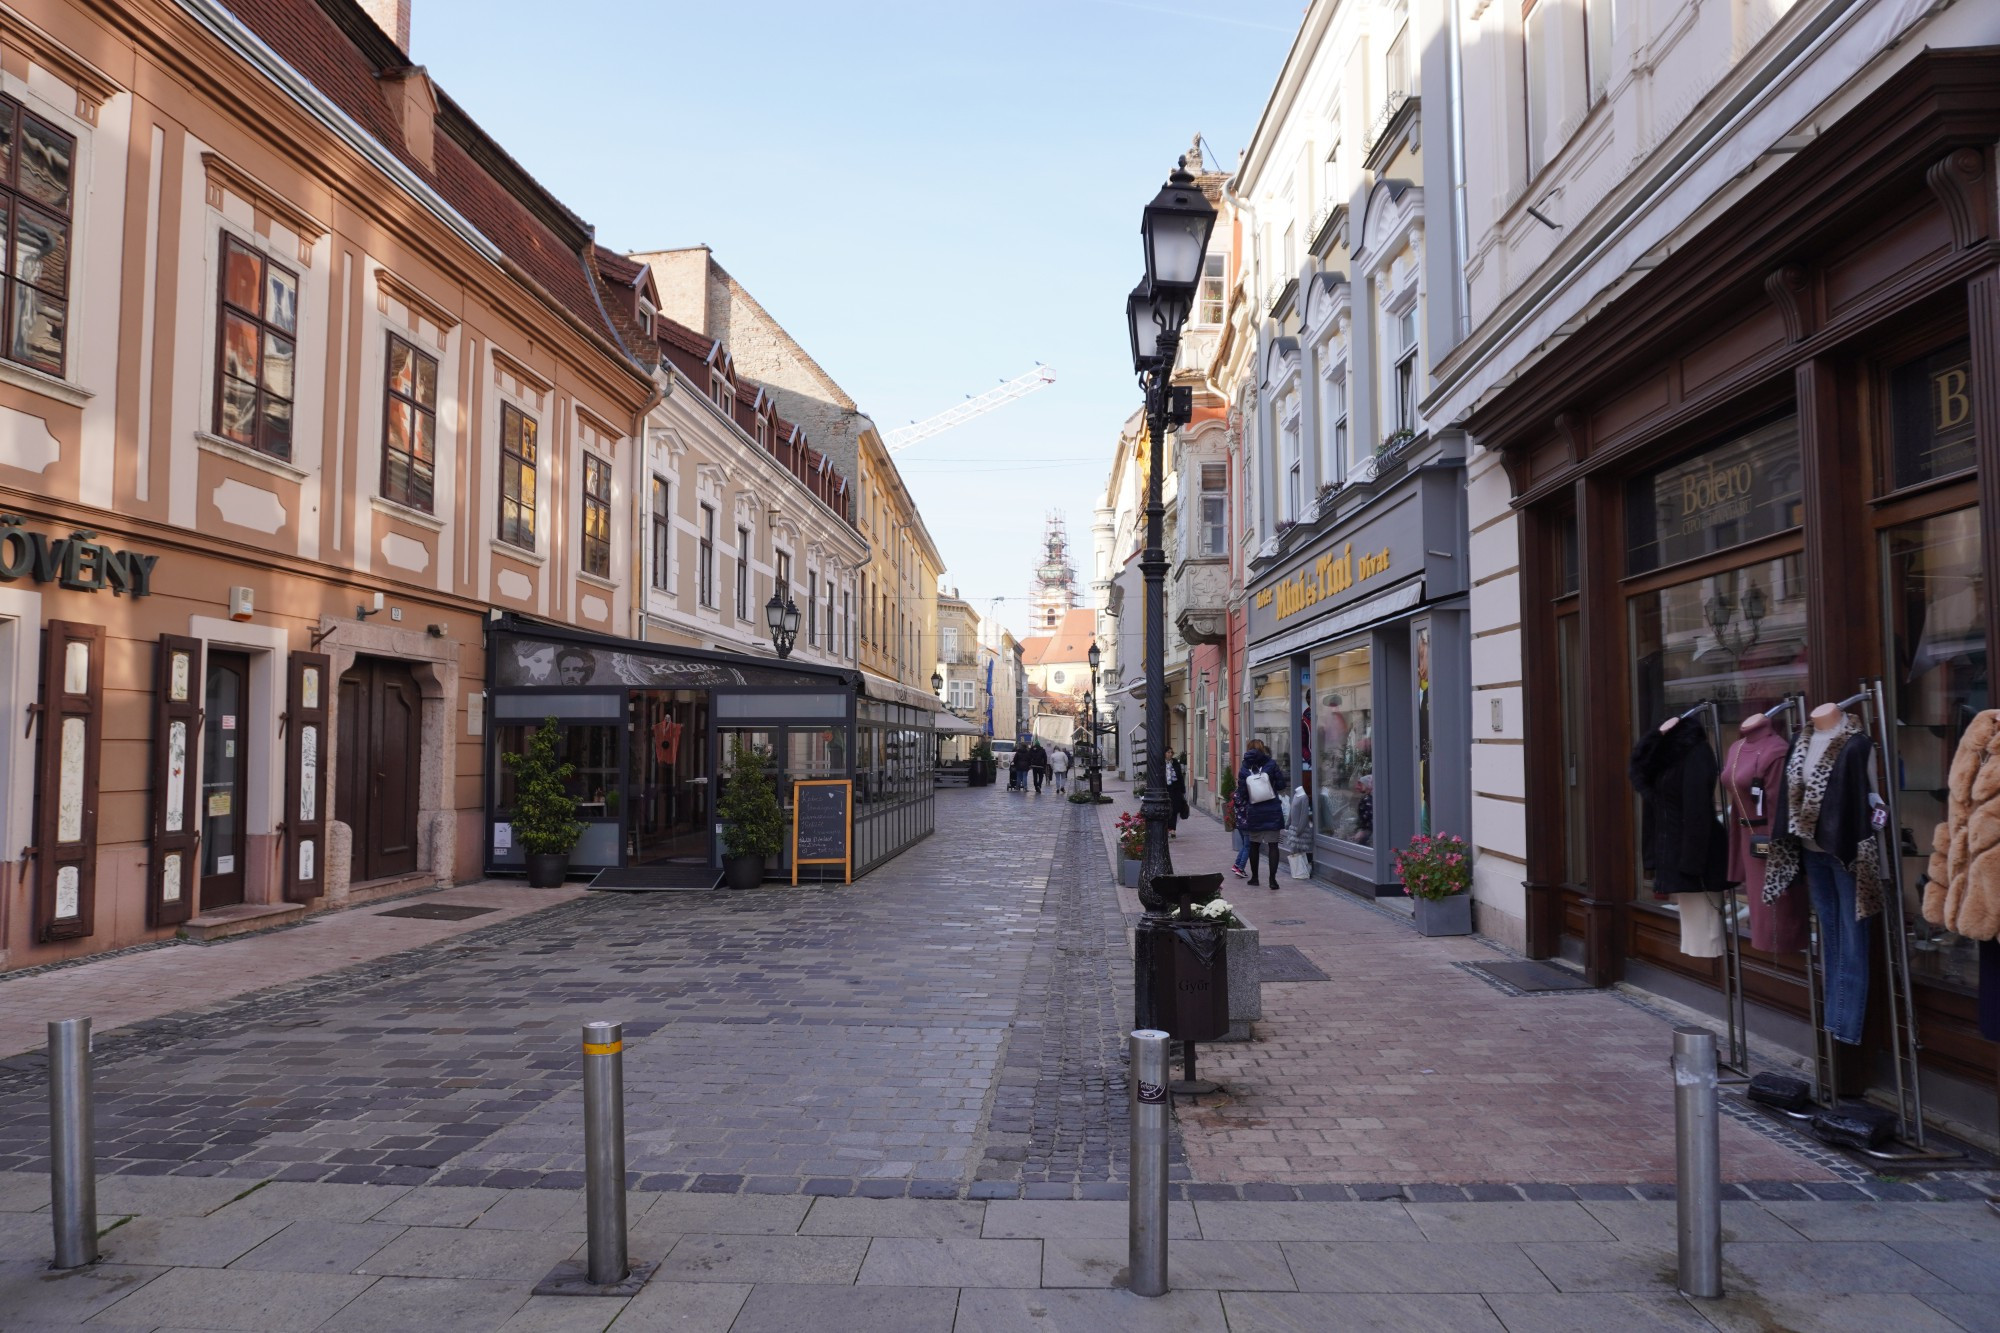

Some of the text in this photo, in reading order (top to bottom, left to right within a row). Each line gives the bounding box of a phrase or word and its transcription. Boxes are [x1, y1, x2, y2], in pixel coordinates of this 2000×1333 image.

[1935, 369, 1970, 430] B
[1681, 461, 1752, 516] Bolero
[1276, 569, 1306, 621] Mini
[1306, 572, 1318, 606] és
[1316, 542, 1353, 601] Tini
[1358, 546, 1390, 582] Divat
[1178, 979, 1210, 994] Győr
